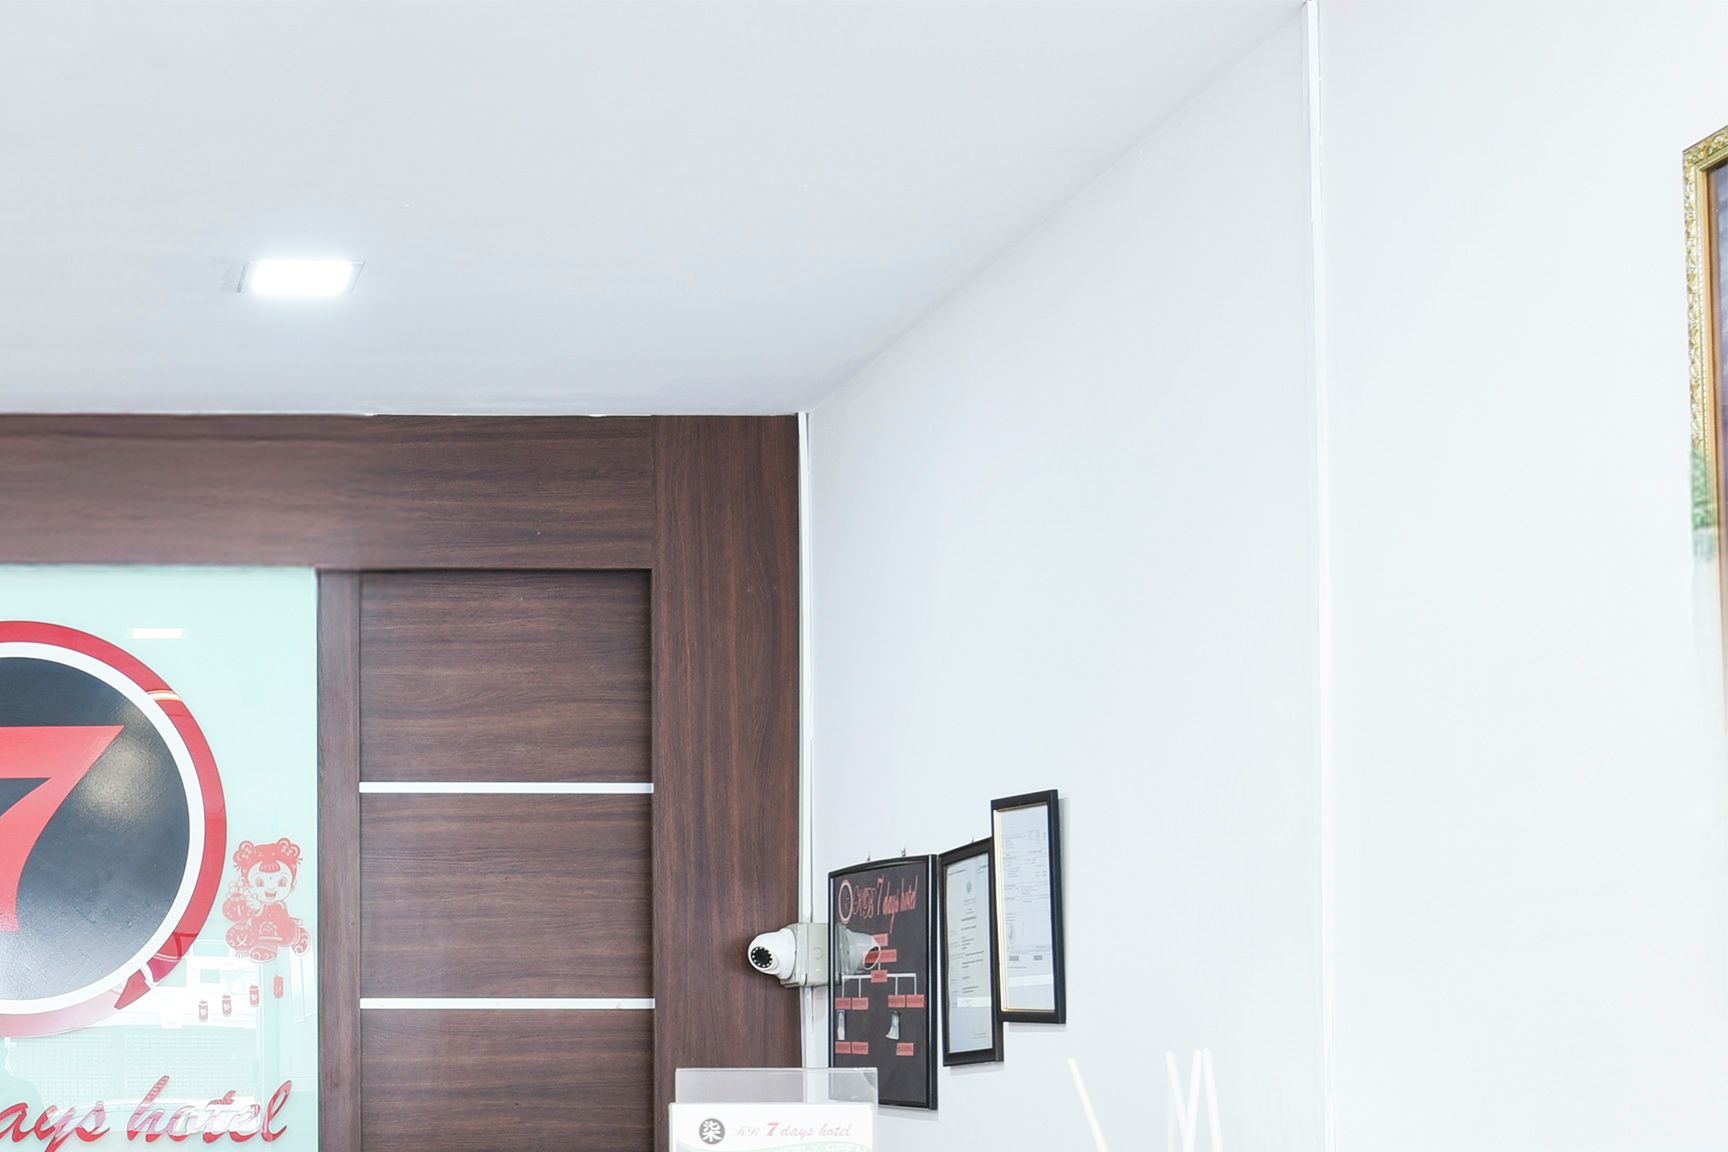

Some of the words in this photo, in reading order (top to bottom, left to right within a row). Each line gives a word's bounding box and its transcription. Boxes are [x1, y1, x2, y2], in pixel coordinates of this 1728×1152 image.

[127, 1074, 294, 1143] hotel
[766, 1122, 780, 1137] 7
[780, 1123, 814, 1140] days
[818, 1123, 852, 1137] hotel
